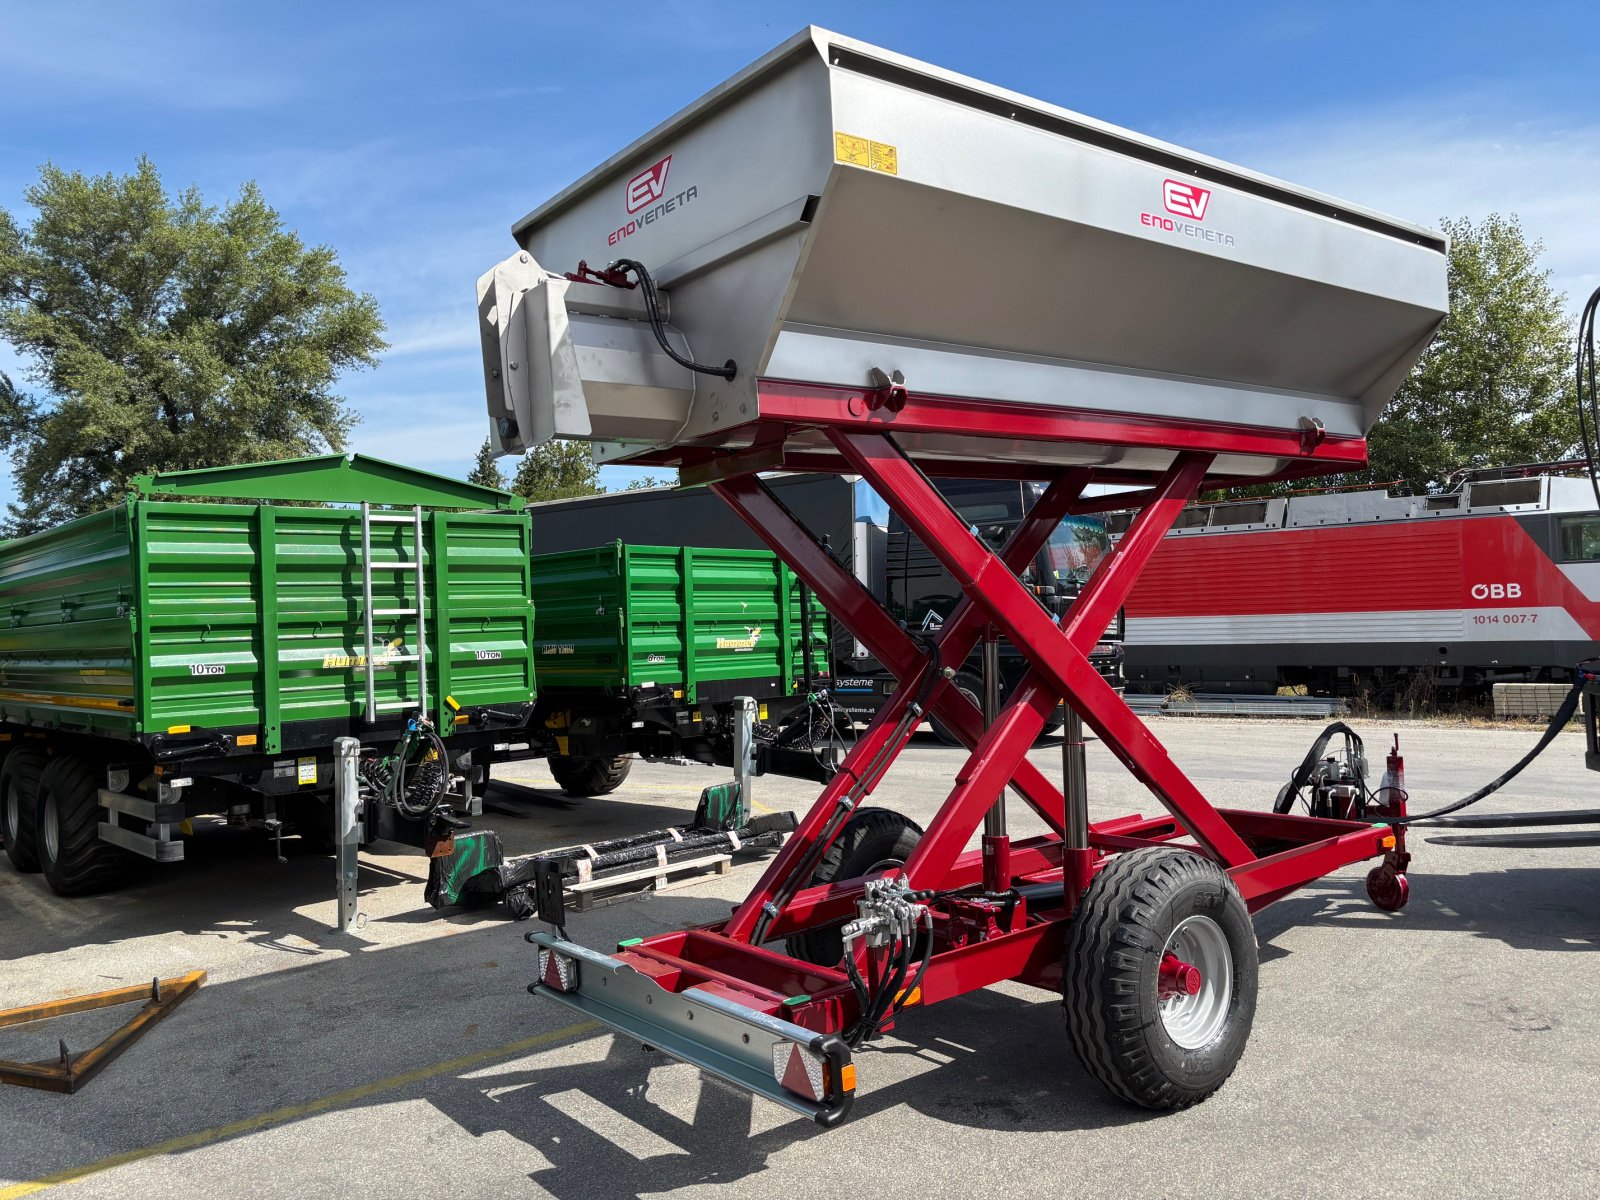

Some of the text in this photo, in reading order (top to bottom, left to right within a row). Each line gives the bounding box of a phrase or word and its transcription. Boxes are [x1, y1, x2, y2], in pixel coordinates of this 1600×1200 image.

[628, 158, 670, 212] EV
[1164, 181, 1209, 219] EV
[608, 185, 698, 246] ENOVENETA
[1141, 213, 1235, 247] ENOVENETA
[1471, 583, 1522, 600] ÖBB
[1472, 614, 1538, 624] 1014 007-7
[476, 650, 486, 659] 10
[190, 664, 224, 675] 10 TON
